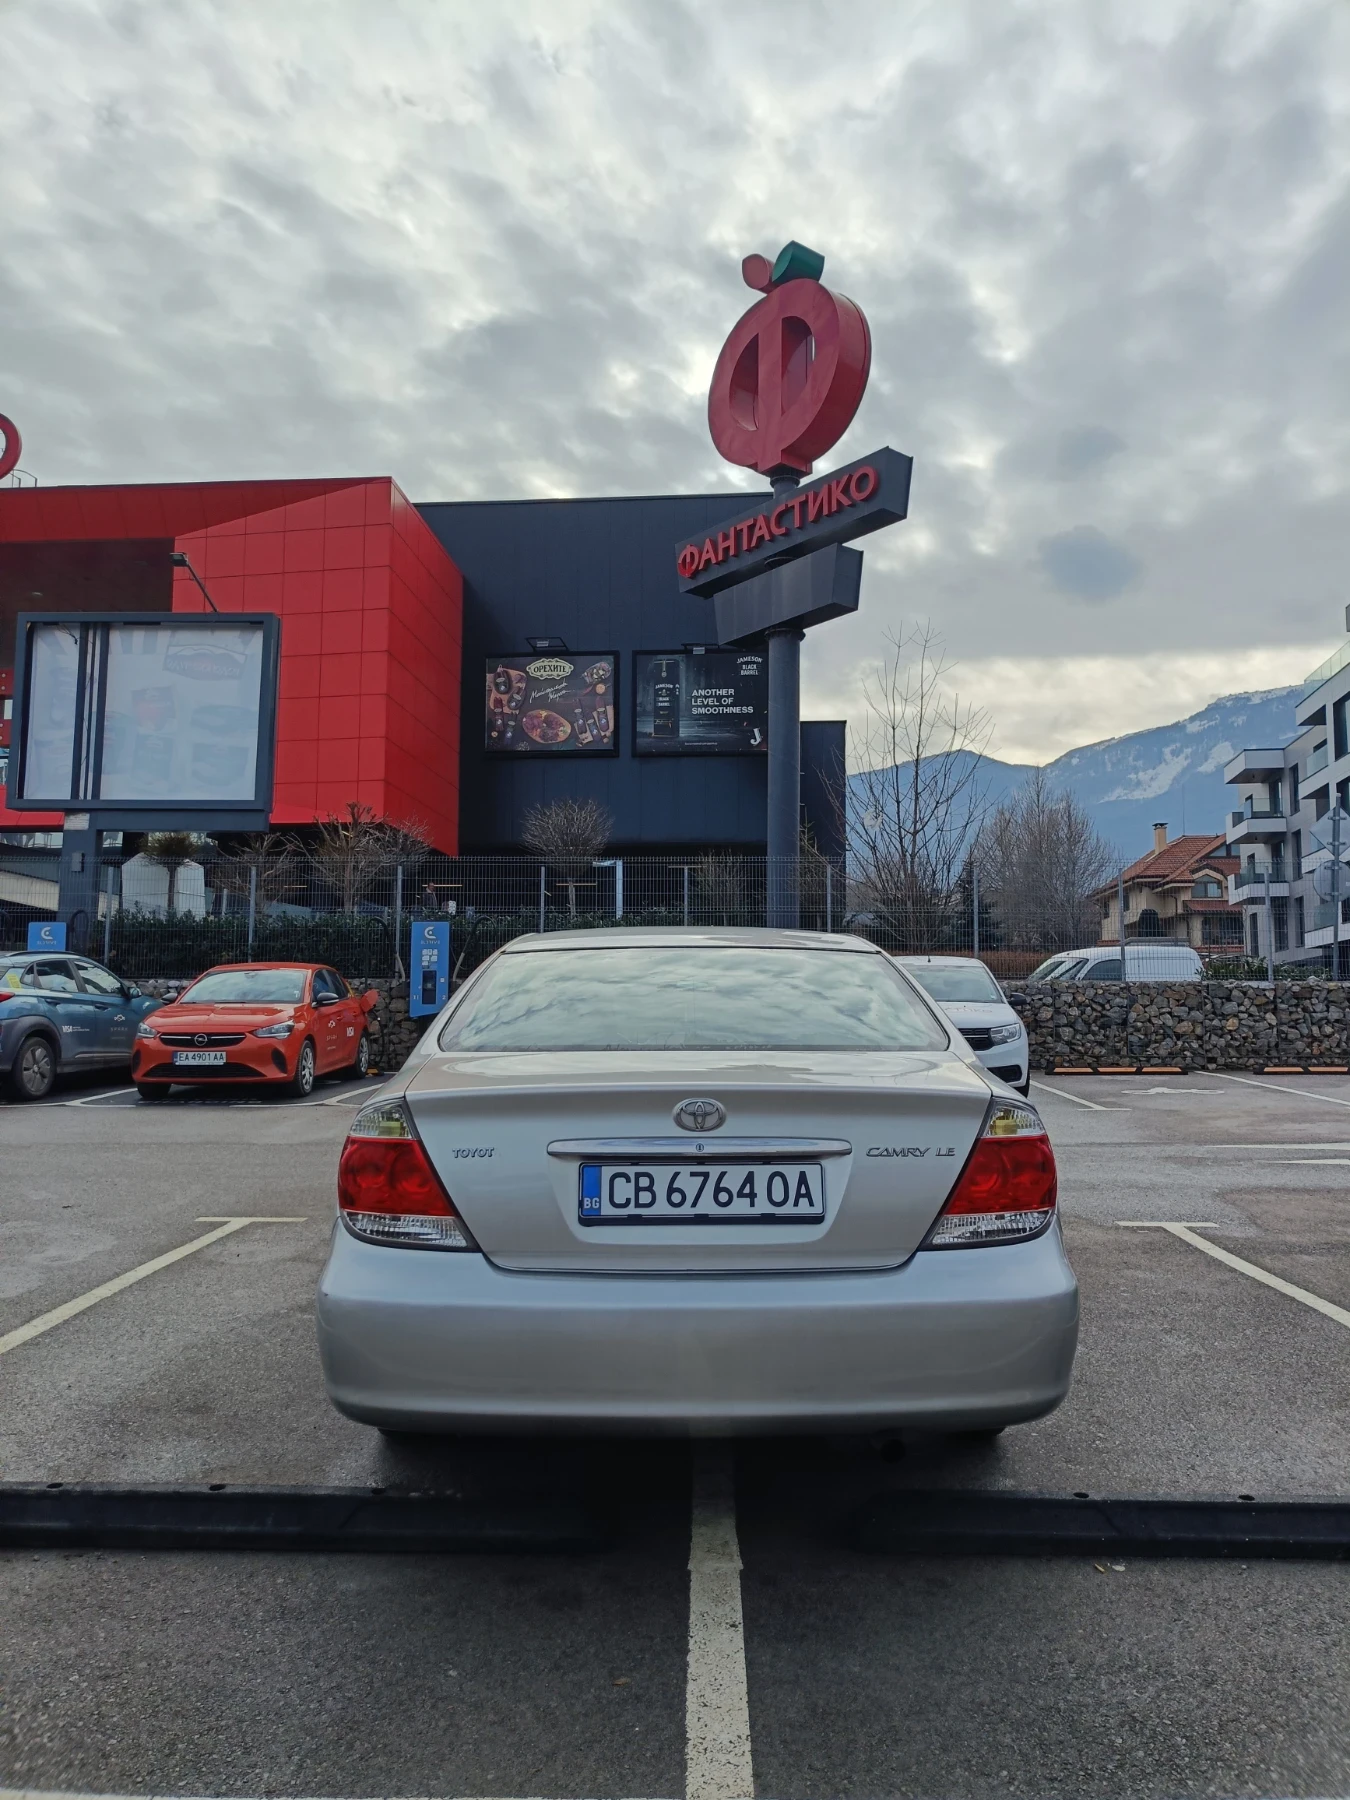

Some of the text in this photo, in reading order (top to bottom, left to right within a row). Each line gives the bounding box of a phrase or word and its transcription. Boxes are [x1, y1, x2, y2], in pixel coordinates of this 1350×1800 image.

[677, 466, 879, 579] ФАНТАСТИКО
[737, 655, 763, 664] JAMESON
[533, 664, 567, 673] ОРЕХИТЕ
[692, 689, 735, 697] ANOTHER
[692, 697, 734, 706] LEVEL OF
[692, 706, 754, 715] SMOOTHNESS
[178, 1053, 225, 1062] EA 4901 AA
[452, 1147, 495, 1159] TOYOT
[865, 1147, 956, 1158] CAMRY LE
[608, 1171, 657, 1209] CB
[666, 1171, 757, 1208] 6764
[583, 1197, 600, 1209] BG
